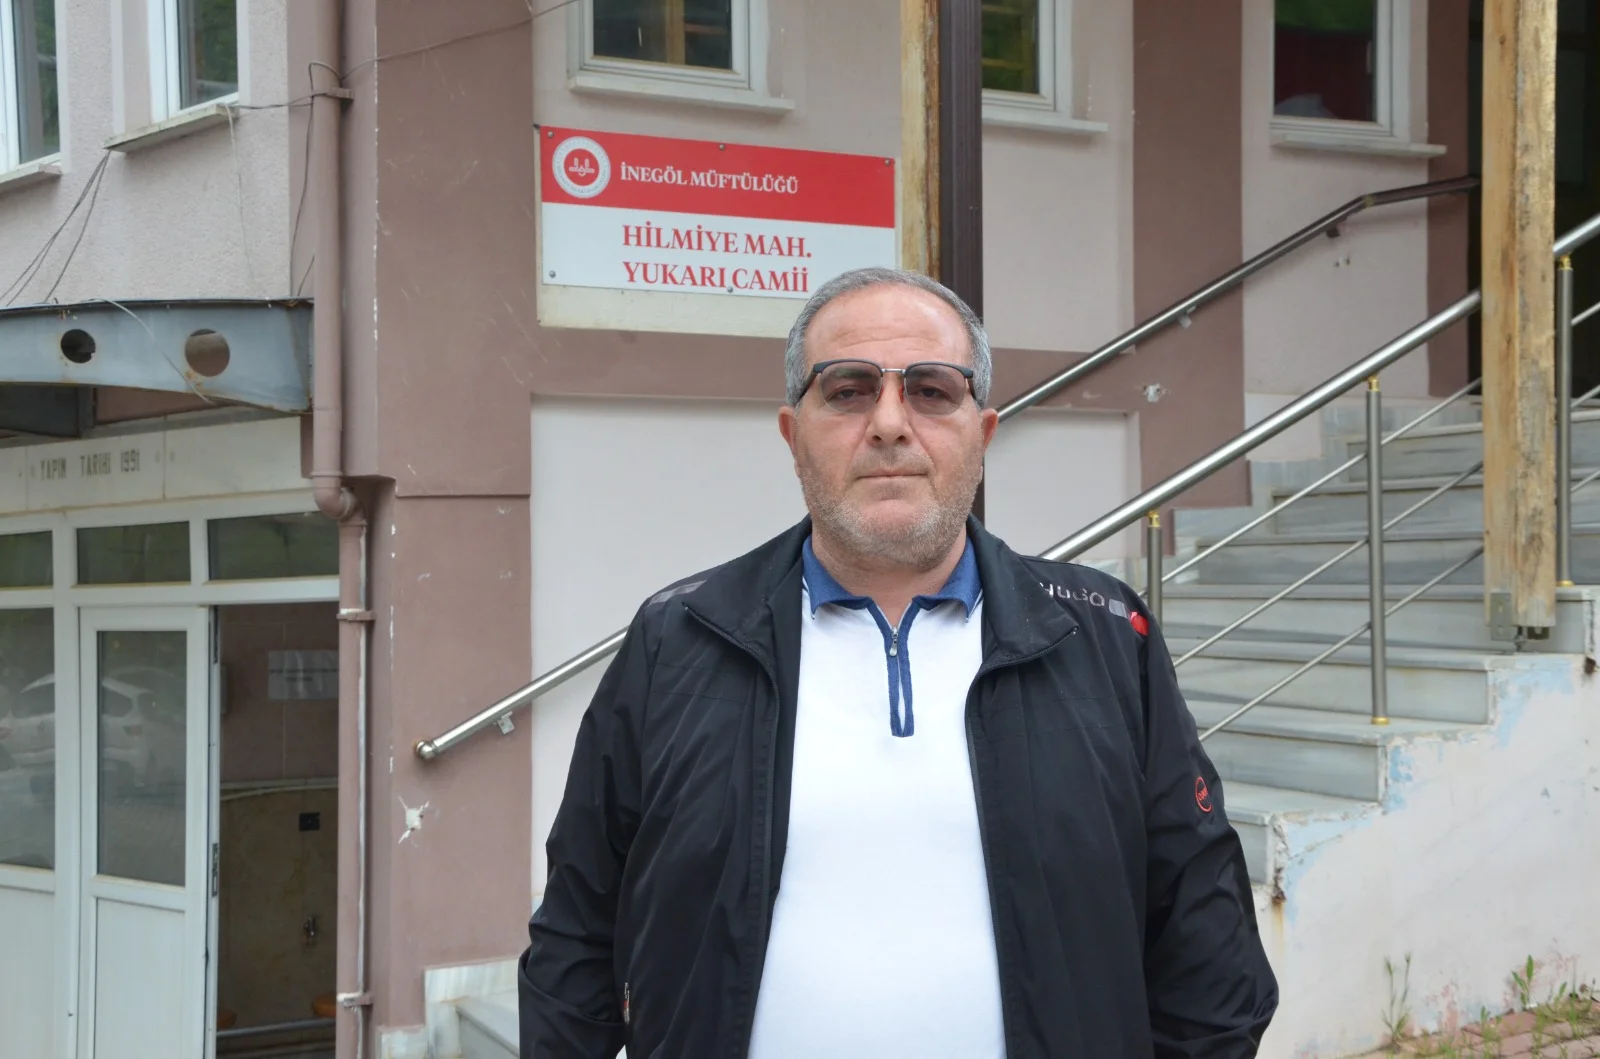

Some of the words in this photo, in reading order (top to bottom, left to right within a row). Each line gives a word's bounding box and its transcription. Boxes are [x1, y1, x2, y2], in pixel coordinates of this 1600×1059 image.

[620, 161, 688, 185] İNEGÖL
[690, 169, 798, 194] MÜFTÜLÜĞÜ
[622, 221, 738, 253] HİLMİYE
[744, 233, 812, 258] MAH.
[622, 261, 726, 289] YUKARI
[732, 267, 809, 293] CAMİİ
[120, 449, 140, 473] 1991
